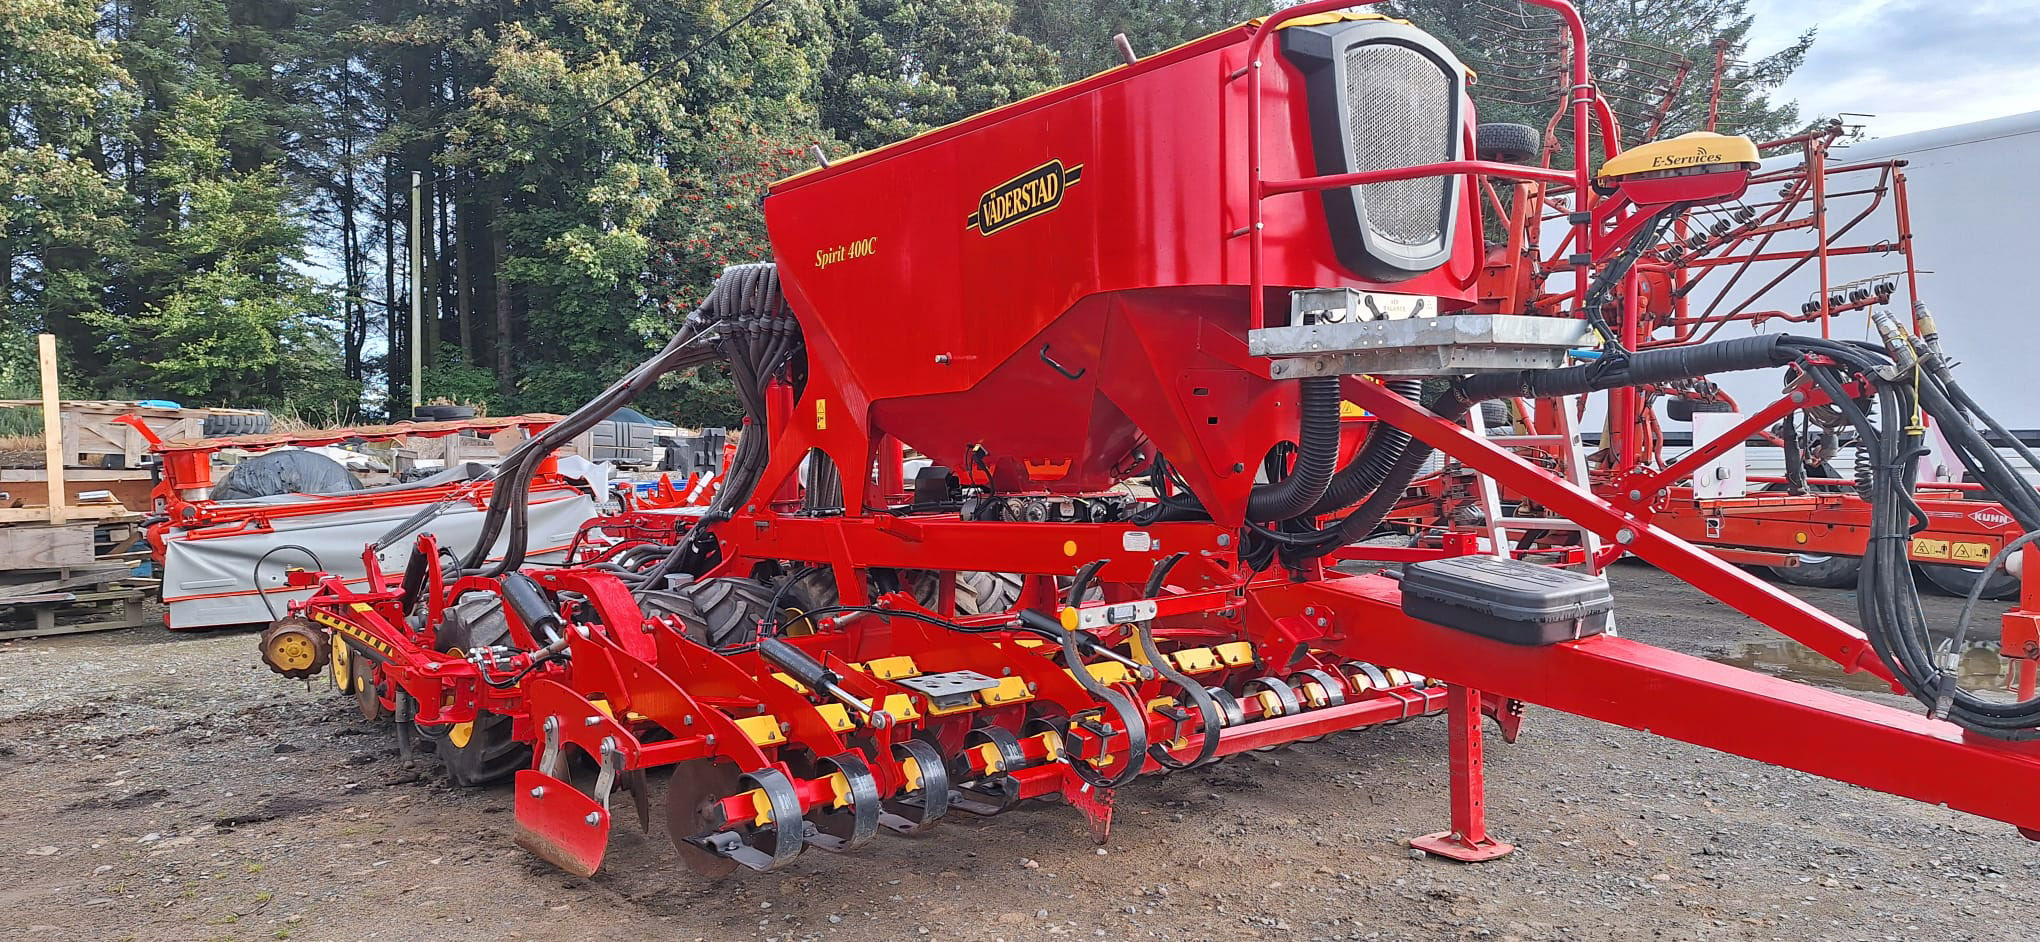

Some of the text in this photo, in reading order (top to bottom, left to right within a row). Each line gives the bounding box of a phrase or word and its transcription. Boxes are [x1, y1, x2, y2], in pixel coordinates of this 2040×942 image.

[1652, 153, 1722, 168] E-Services
[982, 171, 1059, 228] VÄDERSTAD
[815, 236, 878, 270] Spirit 400C
[1974, 512, 2009, 525] KUHN
